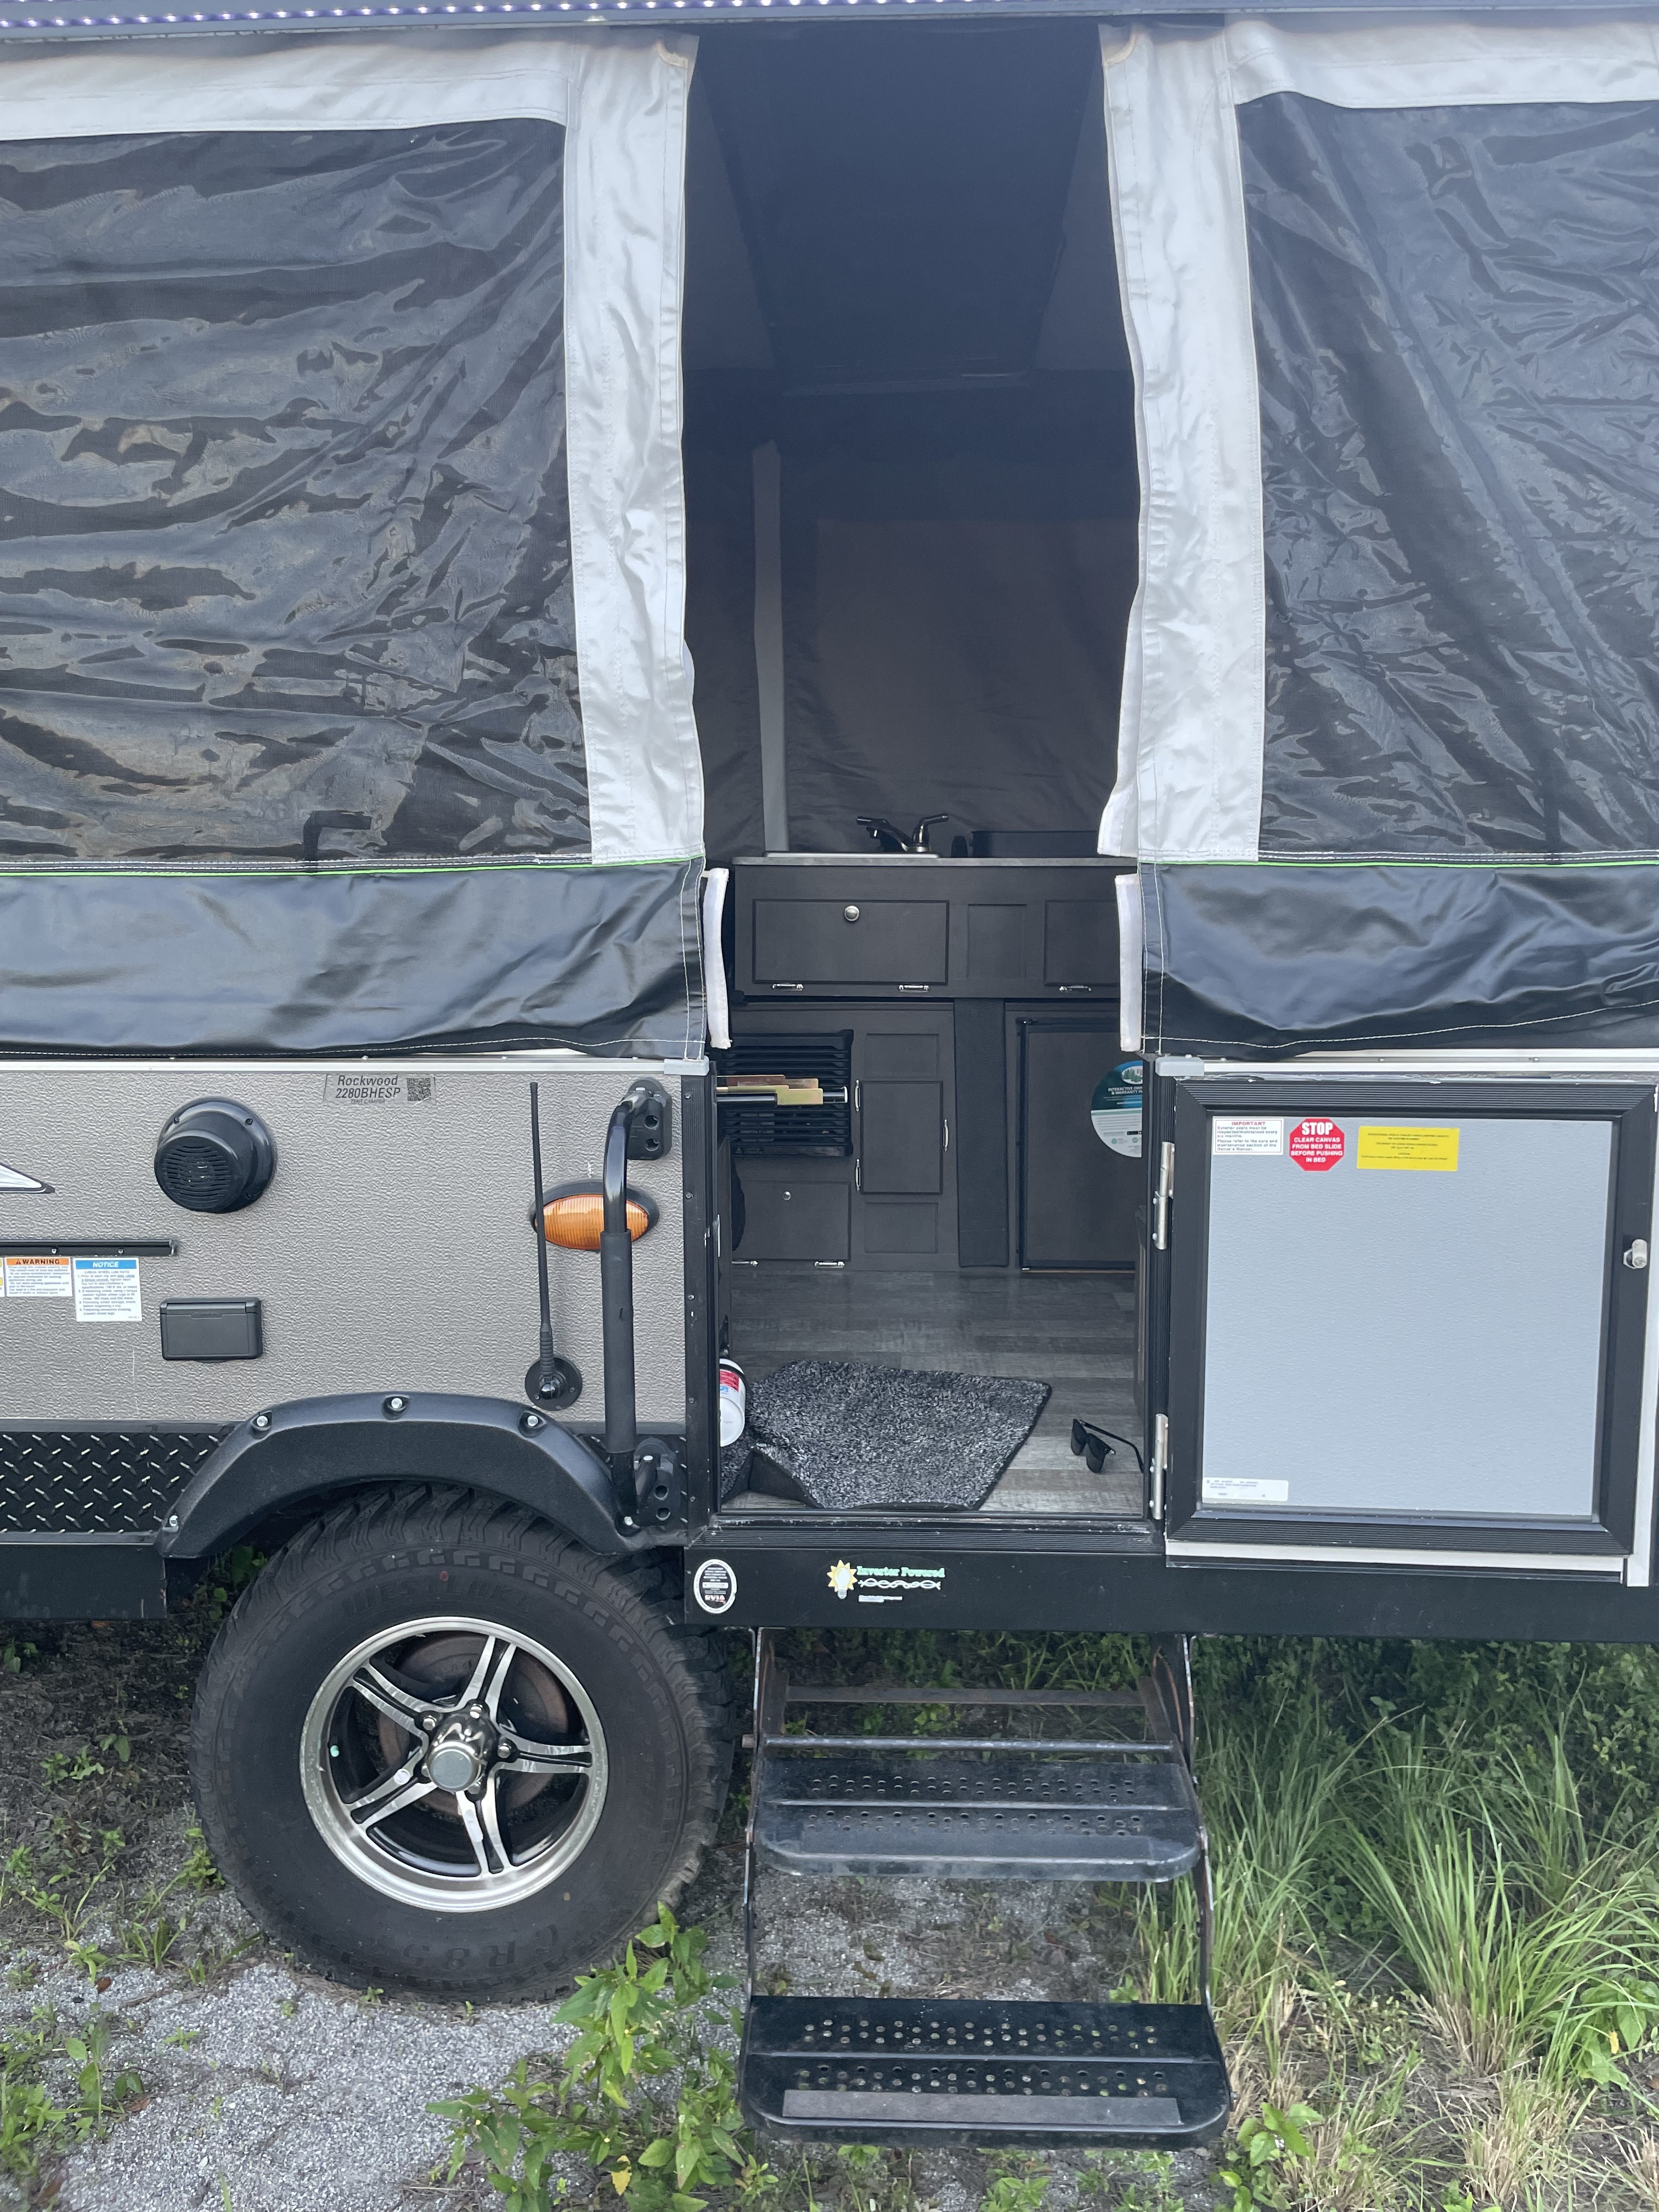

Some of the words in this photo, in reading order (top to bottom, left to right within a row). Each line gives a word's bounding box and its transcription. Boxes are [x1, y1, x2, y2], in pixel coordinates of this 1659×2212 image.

[337, 1075, 398, 1086] Rockwood
[335, 1087, 400, 1098] 2280BHESP
[1302, 1122, 1333, 1135] STOP
[856, 1566, 900, 1576] Inverter
[901, 1567, 945, 1578] Powered
